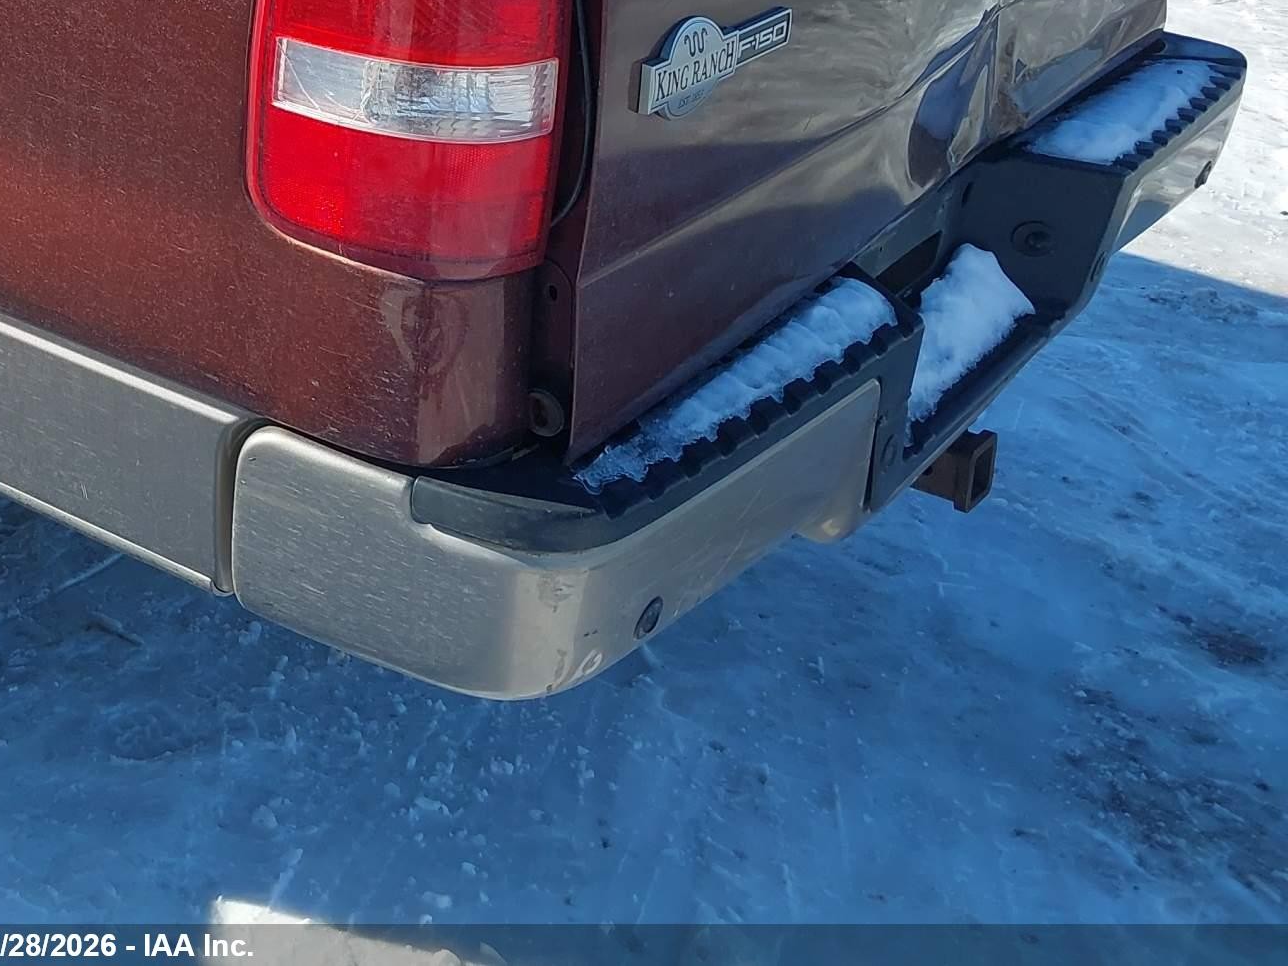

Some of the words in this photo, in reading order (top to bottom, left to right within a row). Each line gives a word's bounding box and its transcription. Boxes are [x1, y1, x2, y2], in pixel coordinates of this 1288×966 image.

[738, 21, 788, 59] F-150
[655, 65, 689, 101] KING
[691, 40, 735, 85] RANCH
